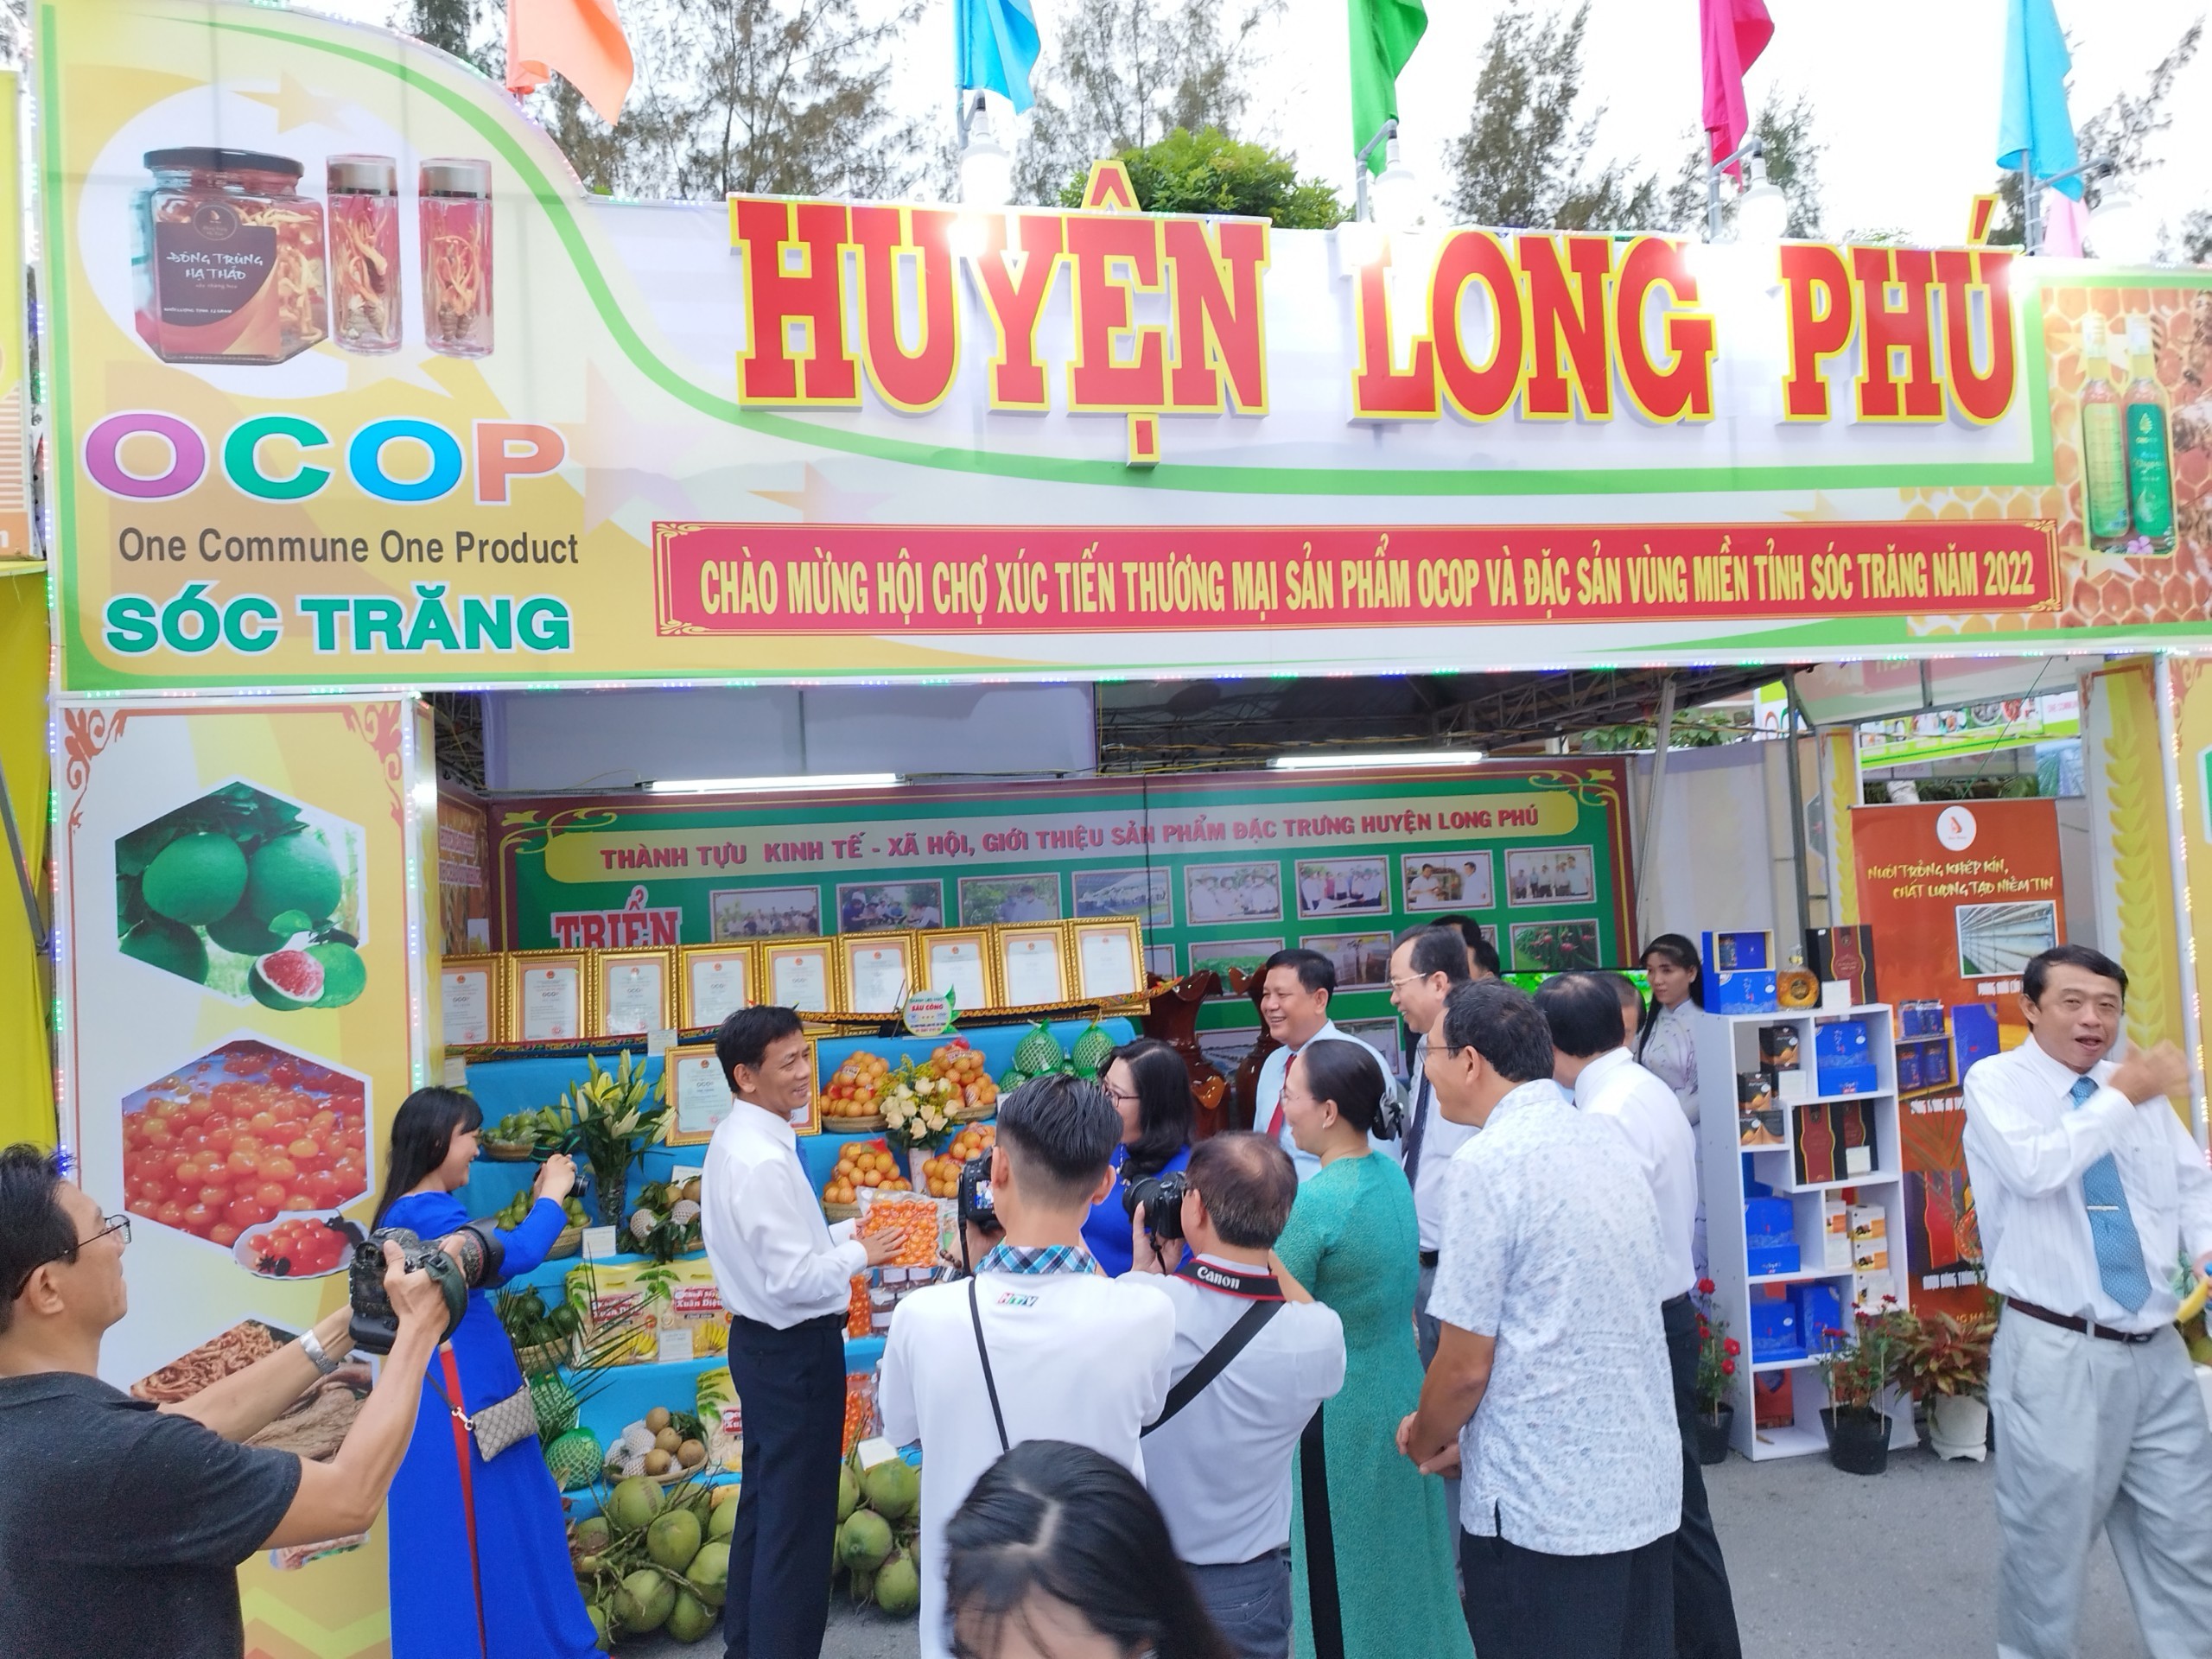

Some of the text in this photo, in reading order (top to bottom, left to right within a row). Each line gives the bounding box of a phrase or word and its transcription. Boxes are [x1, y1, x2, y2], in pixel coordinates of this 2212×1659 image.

[186, 266, 245, 281] HẠ THẢO
[728, 159, 2024, 467] HUYỆN LONG PHÚ
[84, 412, 567, 503] OCOP
[118, 527, 579, 564] One Commune One Product
[701, 533, 2035, 625] CHÀO MỪNG HỘI CHỢ XÚC TIẾN THƯƠNG MẠI SẢN PHẨM OCOP VÀ ĐẶC SẢN VÙNG MIỀN TỈNH SÓC TRĂNG NĂM 2022
[104, 582, 572, 654] SÓC TRĂNG
[600, 843, 688, 869] THÀNH
[696, 842, 747, 868] TỰU
[764, 840, 823, 862] KINH
[831, 831, 865, 860] TẾ
[887, 832, 918, 857] XÃ
[927, 830, 975, 858] HỘI,
[982, 827, 1029, 852] GIỚI
[1035, 824, 1103, 851] THIỆU
[1110, 820, 1155, 846] SẢN
[1162, 815, 1226, 842] PHẨM
[1232, 817, 1277, 844] ĐẶC
[1282, 815, 1355, 837] TRƯNG
[1361, 809, 1431, 834] HUYỆN
[1438, 810, 1492, 830] LONG
[1497, 804, 1539, 827] PHÚ
[551, 885, 682, 950] TRIỂN
[997, 1292, 1039, 1306] HTV
[1197, 1266, 1241, 1290] Canon
